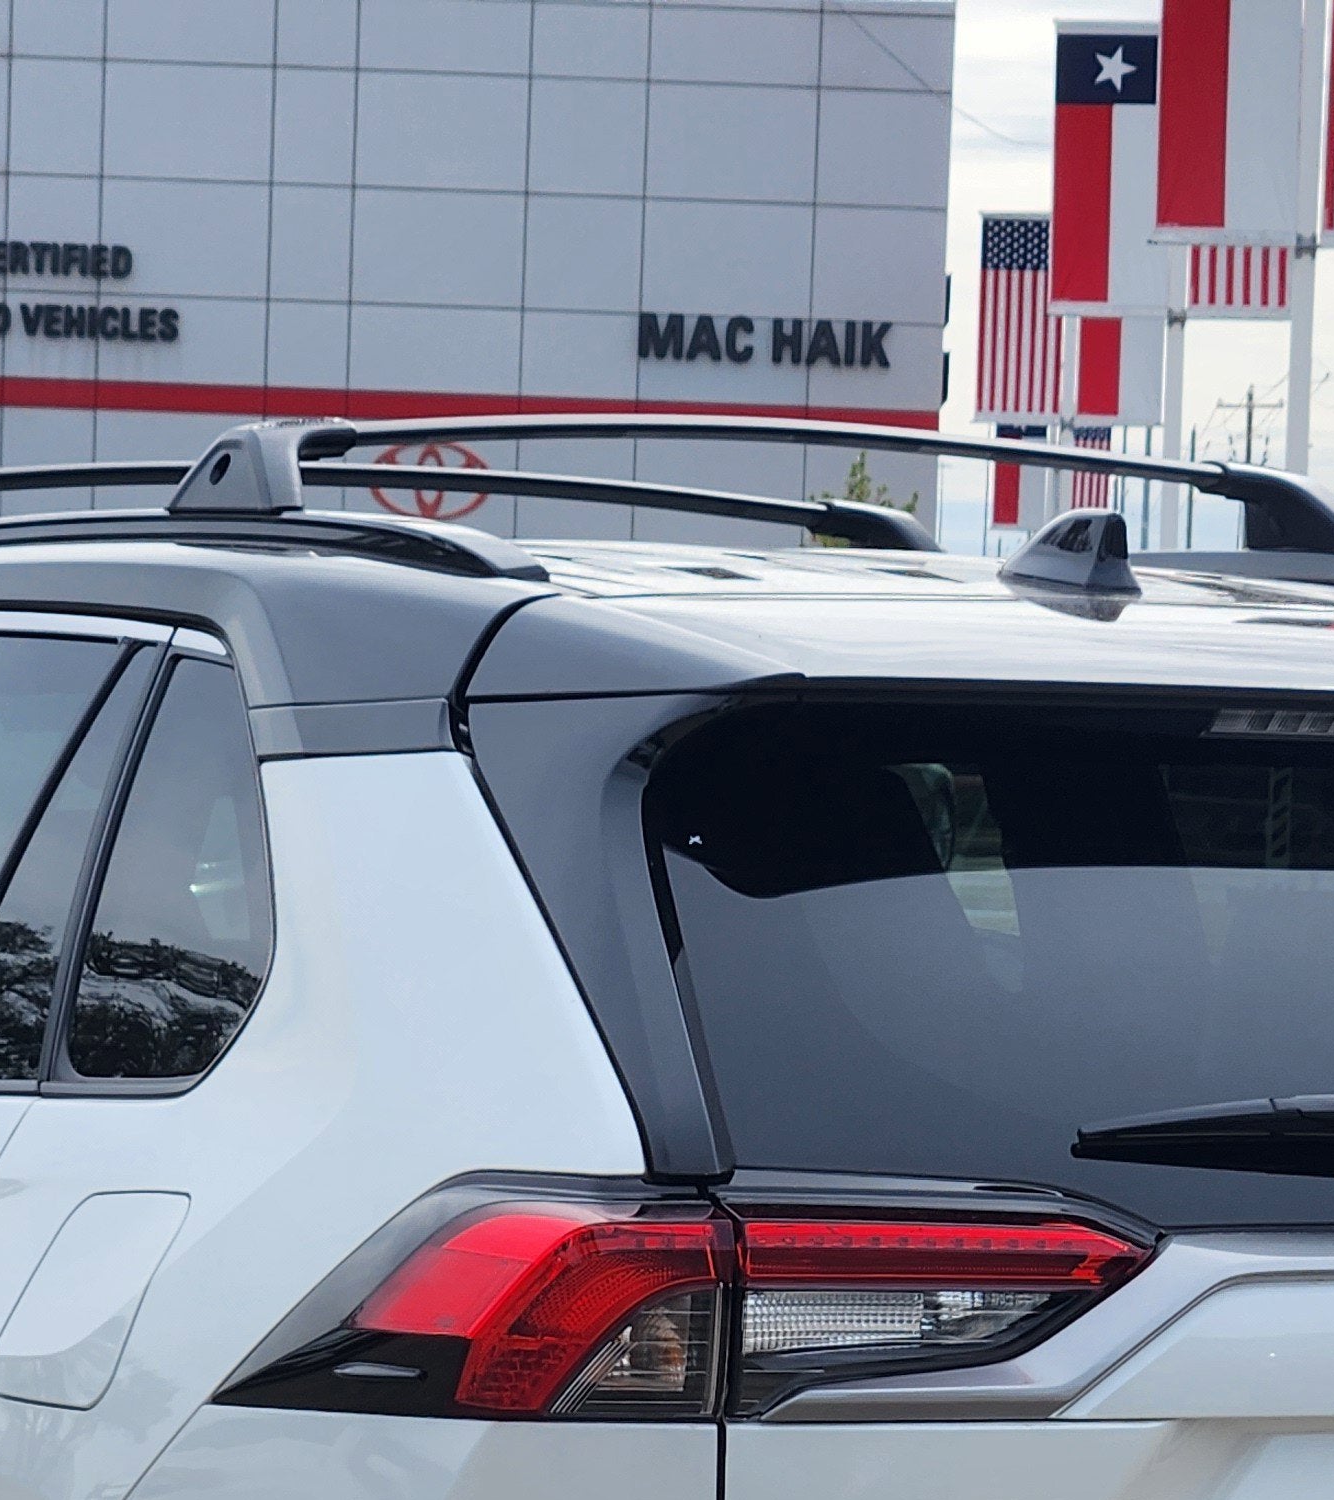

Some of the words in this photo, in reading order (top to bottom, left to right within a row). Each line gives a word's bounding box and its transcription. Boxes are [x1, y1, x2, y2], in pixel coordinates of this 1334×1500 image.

[19, 303, 179, 342] VEHICLES
[638, 311, 754, 363] MAC
[771, 317, 893, 369] HAIK
